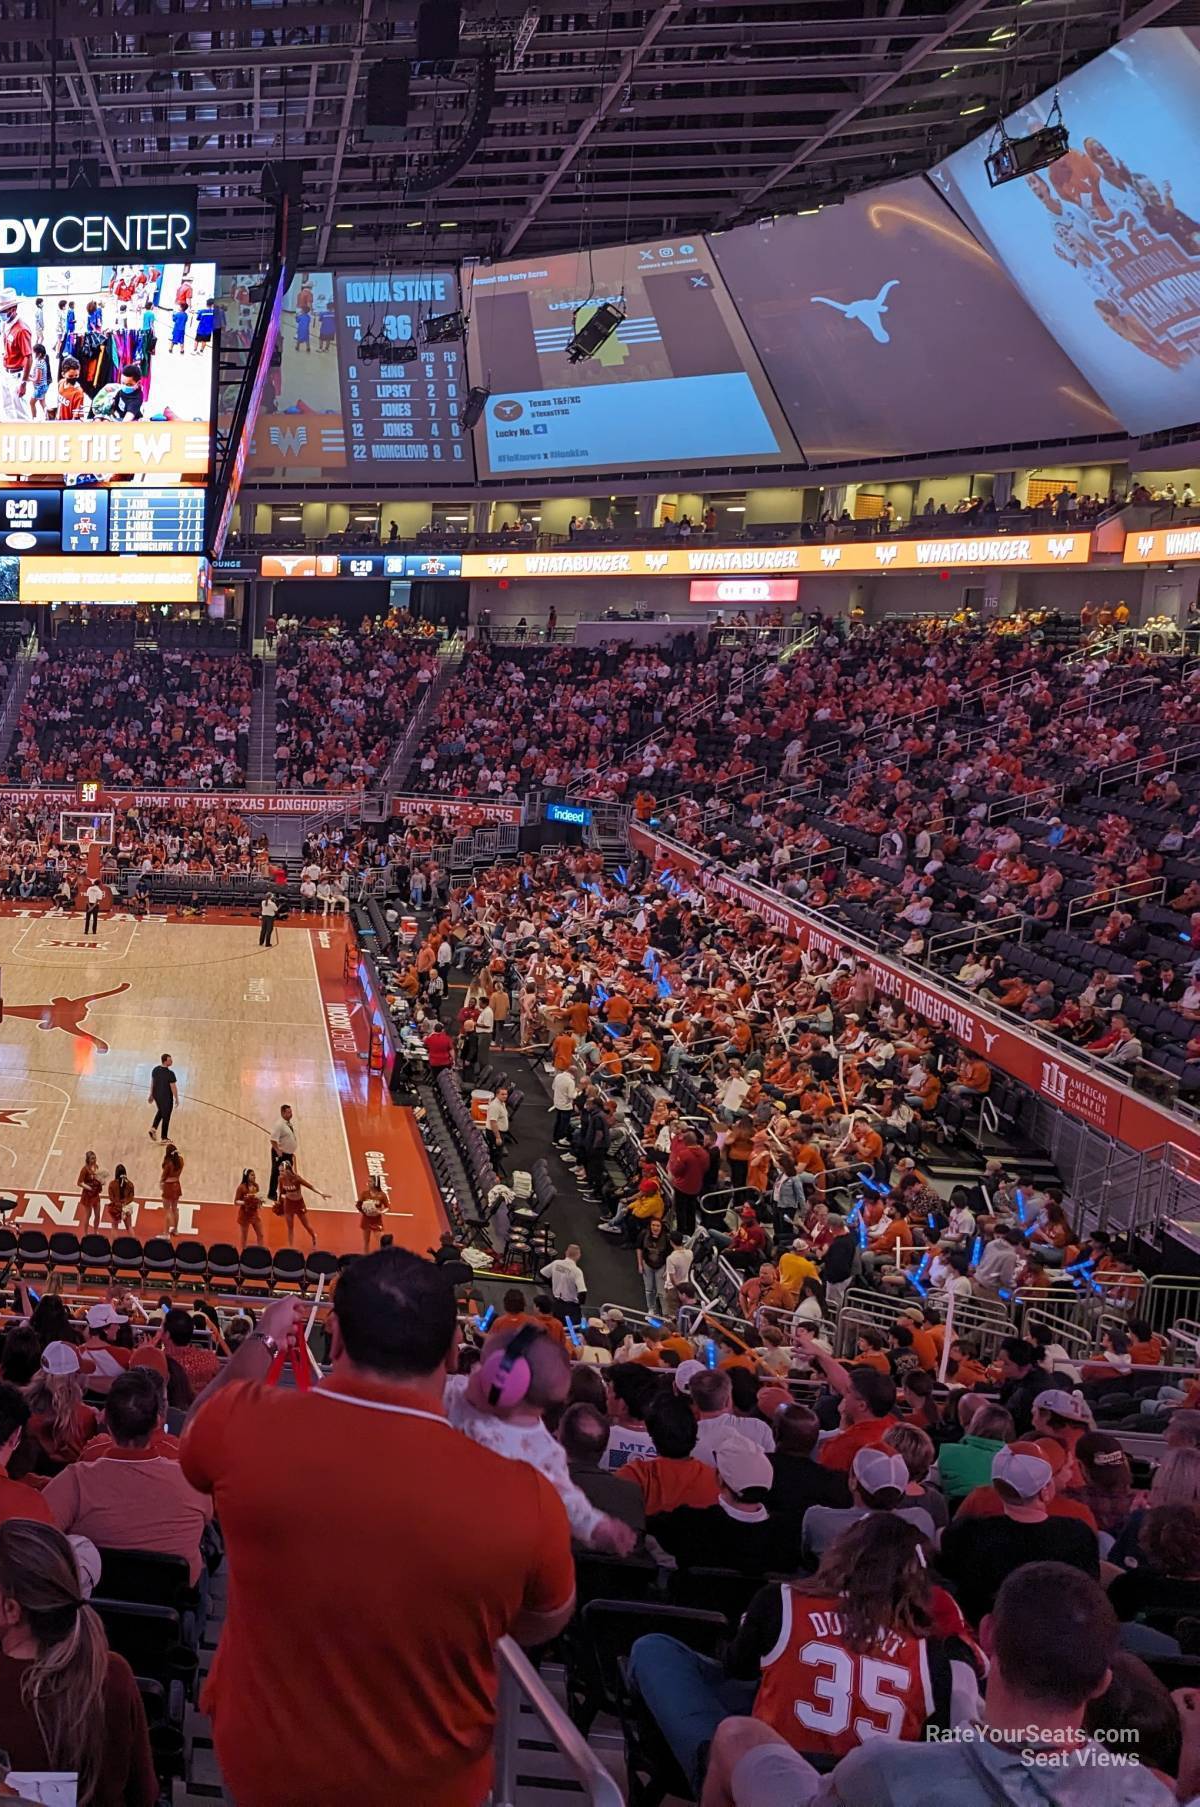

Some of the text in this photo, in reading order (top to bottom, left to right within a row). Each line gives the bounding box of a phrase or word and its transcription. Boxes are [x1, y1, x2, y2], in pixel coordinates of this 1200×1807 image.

[52, 213, 191, 253] CENTER
[1117, 248, 1186, 289] NATIONAL
[473, 270, 548, 286] Around the Forty Acres
[346, 280, 446, 304] IOWA STATE
[346, 315, 361, 328] TOL
[383, 315, 412, 341] 36
[354, 330, 361, 341] 4
[421, 351, 457, 362] PTS FLS
[349, 366, 357, 379] 0
[380, 364, 405, 378] KING
[426, 364, 433, 378] 5
[351, 384, 456, 398] 3 LIPSEY 2 0
[352, 403, 458, 417] 5 JONES 7 0
[528, 396, 581, 408] Texas T&F/XC
[353, 424, 364, 437] 12
[383, 423, 413, 437] JONES
[431, 423, 439, 436] 4
[496, 427, 532, 438] Lucky No.
[2, 433, 71, 463] HOME
[79, 433, 122, 462] THE
[353, 445, 367, 459] 22
[454, 444, 462, 459] 0
[6, 499, 38, 520] 6:20
[916, 539, 1031, 564] WHATABURGER
[212, 560, 241, 568] OUNGE
[350, 559, 373, 572] 6:20
[526, 554, 631, 573] WHATABURGER
[688, 550, 799, 570] WHATABURGER
[43, 792, 79, 805] CENT
[81, 791, 95, 802] 30
[135, 796, 346, 812] HOME OF THE TEXAS LONGHORNS
[400, 801, 432, 815] HOOK
[554, 807, 584, 823] indeed
[12, 909, 169, 923] TEXAS
[730, 886, 740, 899] TO
[739, 889, 762, 913] MOODY
[761, 902, 790, 934] CENTER
[535, 967, 543, 976] 11
[808, 929, 974, 1042] HOME TEXAS LONGHORNS
[1069, 1078, 1108, 1105] AMERICAN
[1067, 1089, 1107, 1117] CAMPUS
[1066, 1100, 1105, 1126] COMMUNITIES
[794, 1640, 911, 1745] 35
